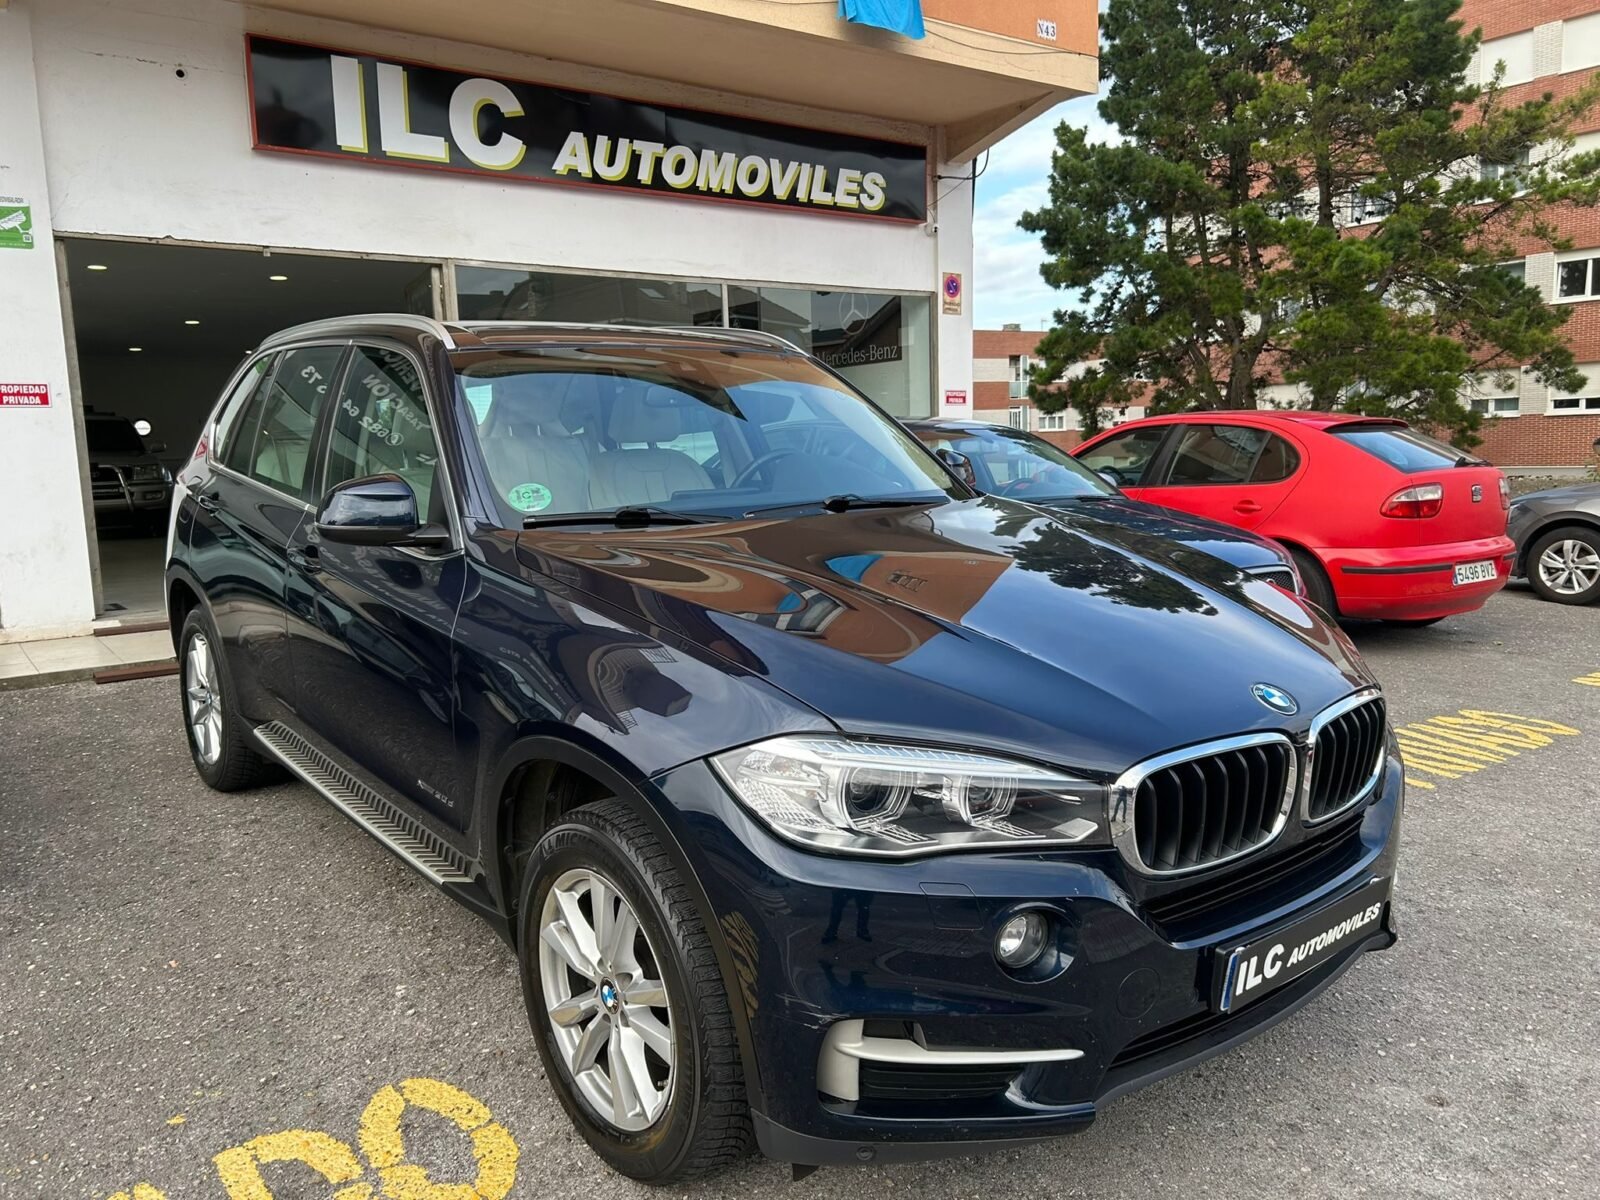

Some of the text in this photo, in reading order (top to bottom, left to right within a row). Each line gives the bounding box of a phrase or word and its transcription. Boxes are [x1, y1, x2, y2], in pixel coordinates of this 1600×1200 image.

[330, 54, 887, 210] ILC AUTOMOVILES
[815, 344, 898, 365] Mercedes-Benz
[0, 385, 47, 394] ROPIEDAD
[2, 396, 41, 404] PRIVADA
[1457, 565, 1480, 582] 5496
[1235, 902, 1382, 996] ILC AUTOMOVILES
